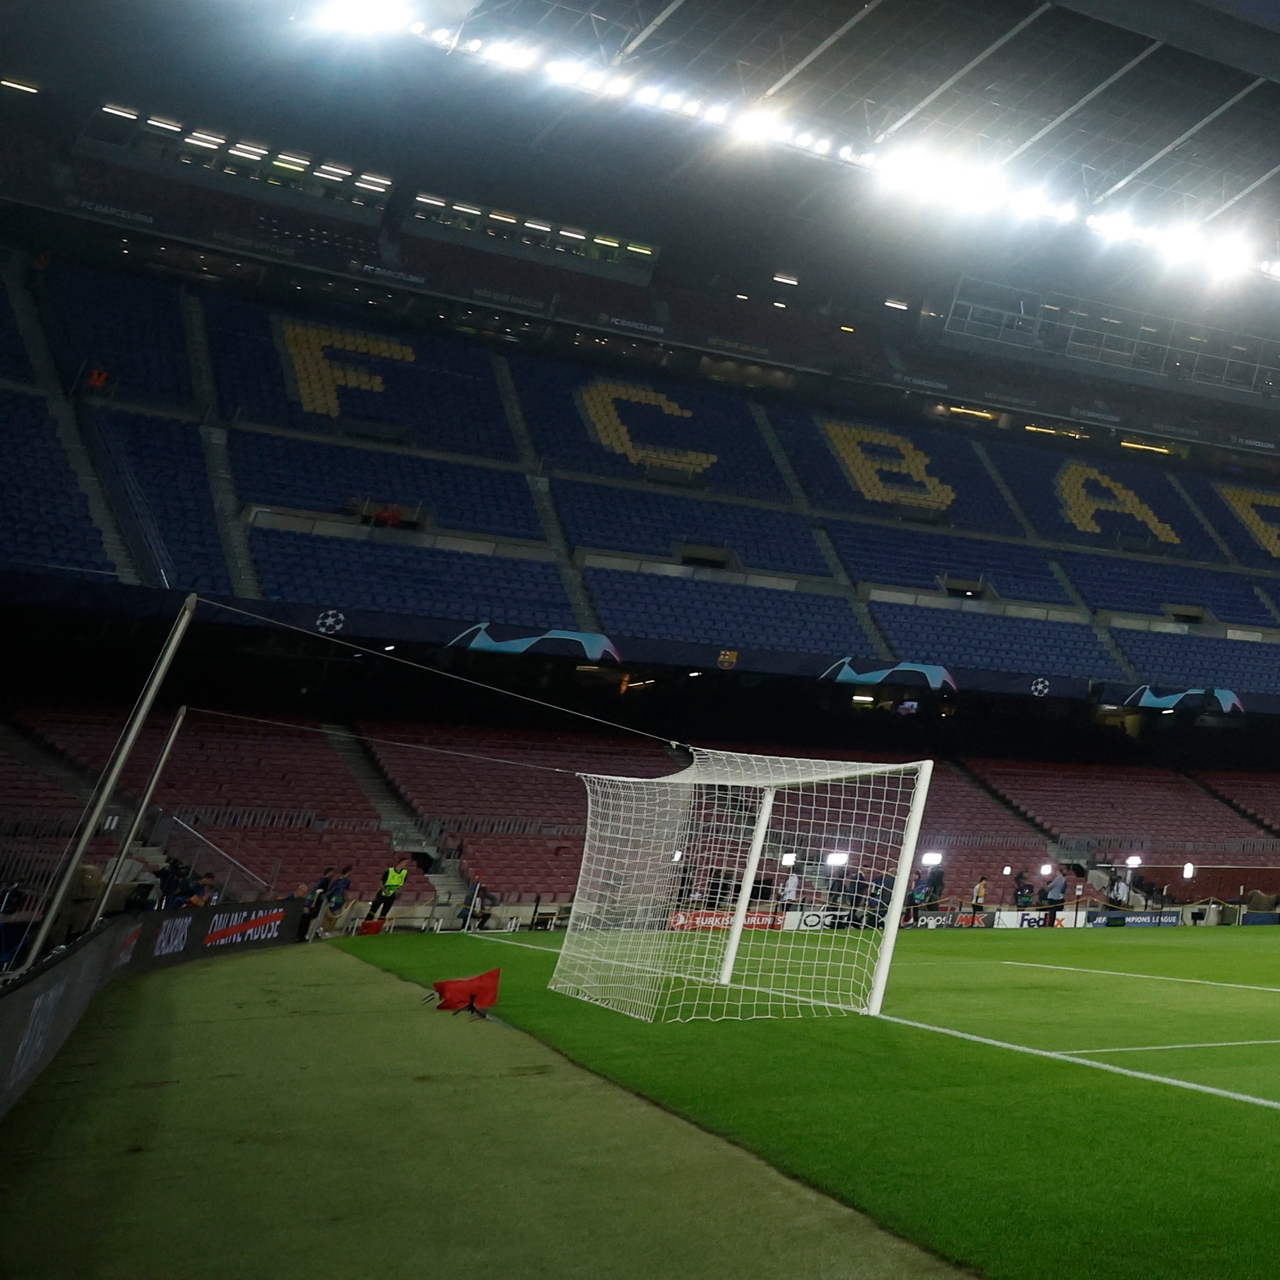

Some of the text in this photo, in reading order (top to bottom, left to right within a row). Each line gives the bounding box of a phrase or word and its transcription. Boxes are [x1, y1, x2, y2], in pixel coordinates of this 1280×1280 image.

[206, 911, 247, 948] ONLINE
[244, 908, 284, 941] ABUSE
[743, 916, 783, 925] AIRLINS
[1020, 912, 1066, 928] Fedx
